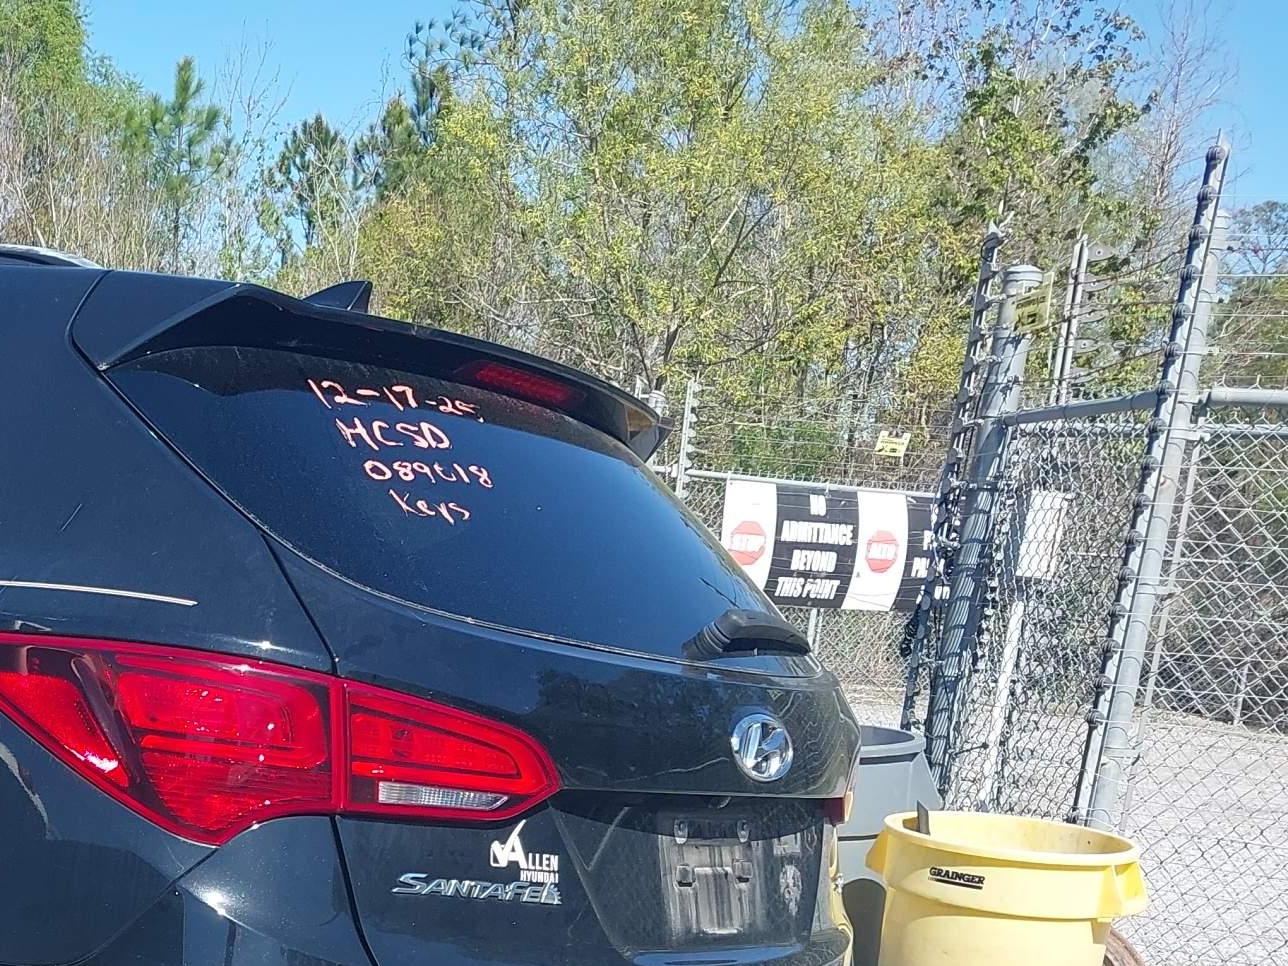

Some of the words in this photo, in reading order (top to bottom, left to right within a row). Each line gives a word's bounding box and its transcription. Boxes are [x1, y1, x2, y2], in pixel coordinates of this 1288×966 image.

[335, 416, 453, 450] HCSD
[388, 488, 471, 525] Keys
[809, 494, 827, 516] NO
[780, 520, 854, 546] ADMITTANCE
[790, 549, 838, 573] BEYOND
[774, 577, 804, 598] THIS
[802, 578, 841, 600] POINT
[520, 869, 559, 883] HYUNDAI
[929, 867, 985, 885] GRAINGER
